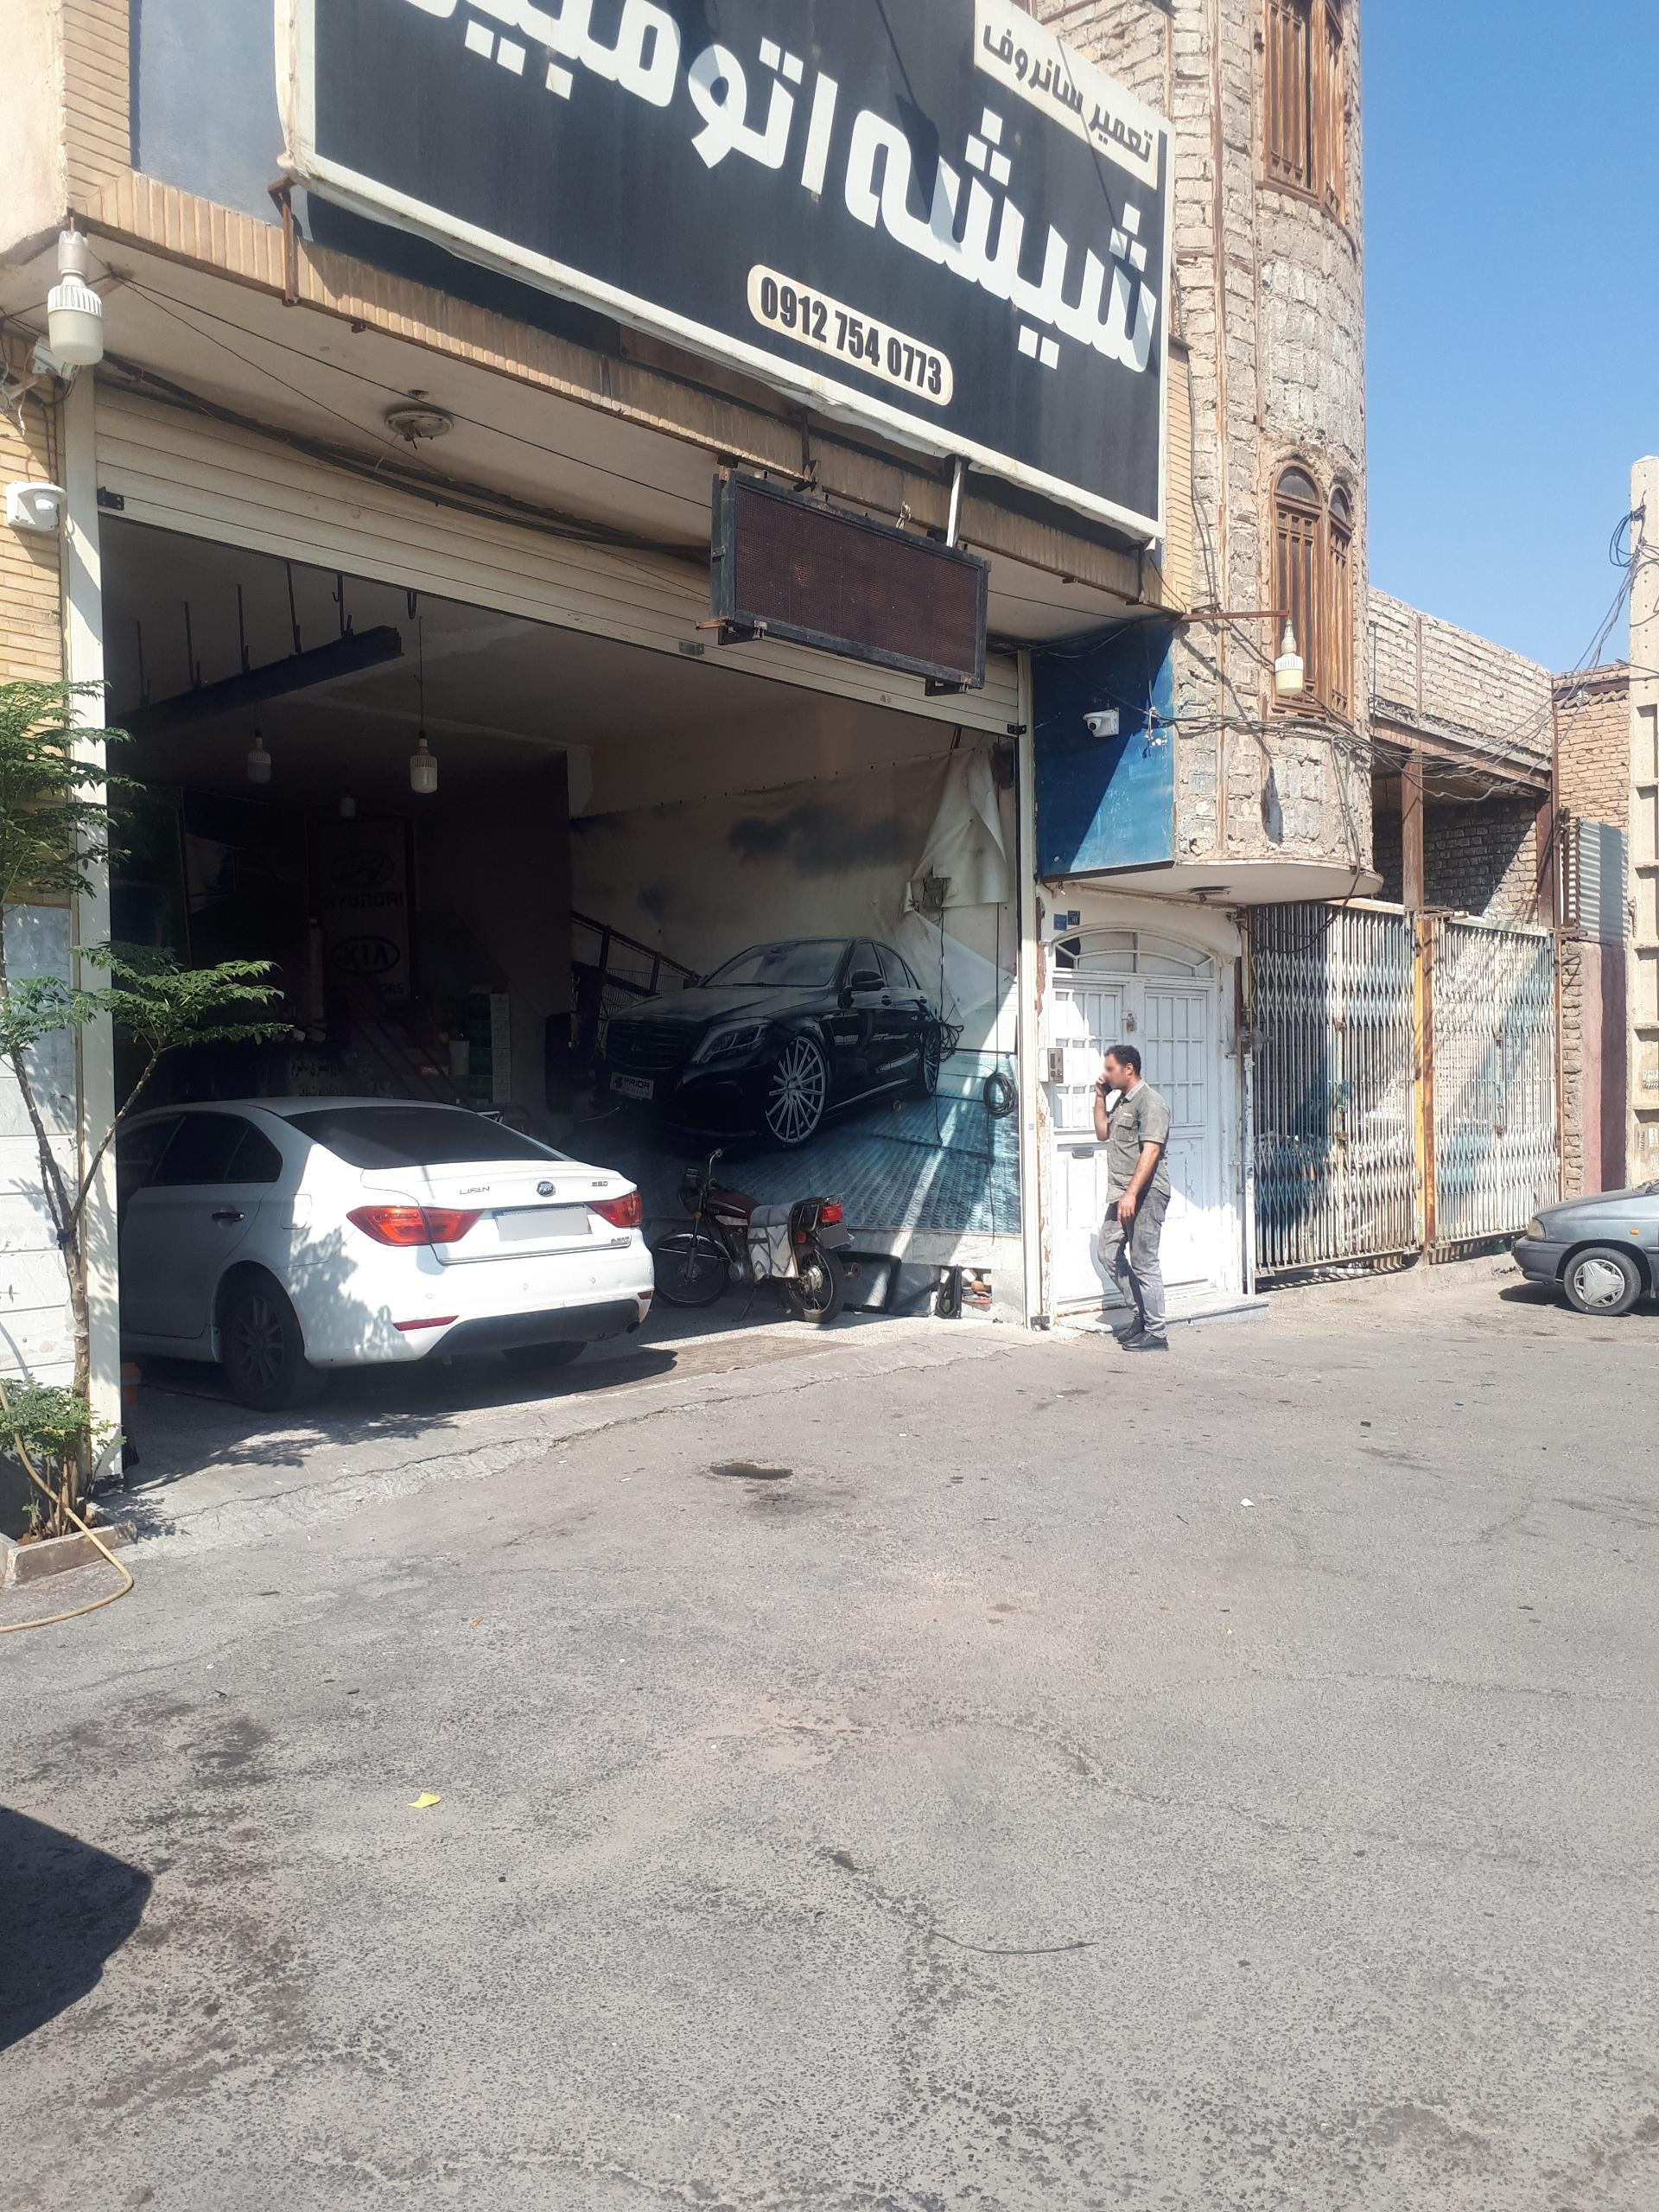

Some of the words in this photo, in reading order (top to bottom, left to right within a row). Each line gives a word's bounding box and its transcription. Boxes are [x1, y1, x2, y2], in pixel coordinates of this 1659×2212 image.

[402, 0, 838, 196] اتومبی
[982, 25, 1084, 115] سانروف
[1089, 104, 1154, 163] تعمیر
[845, 107, 1157, 373] شیشه
[760, 276, 828, 344] 0912
[835, 309, 880, 367] 754
[887, 337, 942, 396] 0773
[324, 891, 404, 908] HYUNDAI
